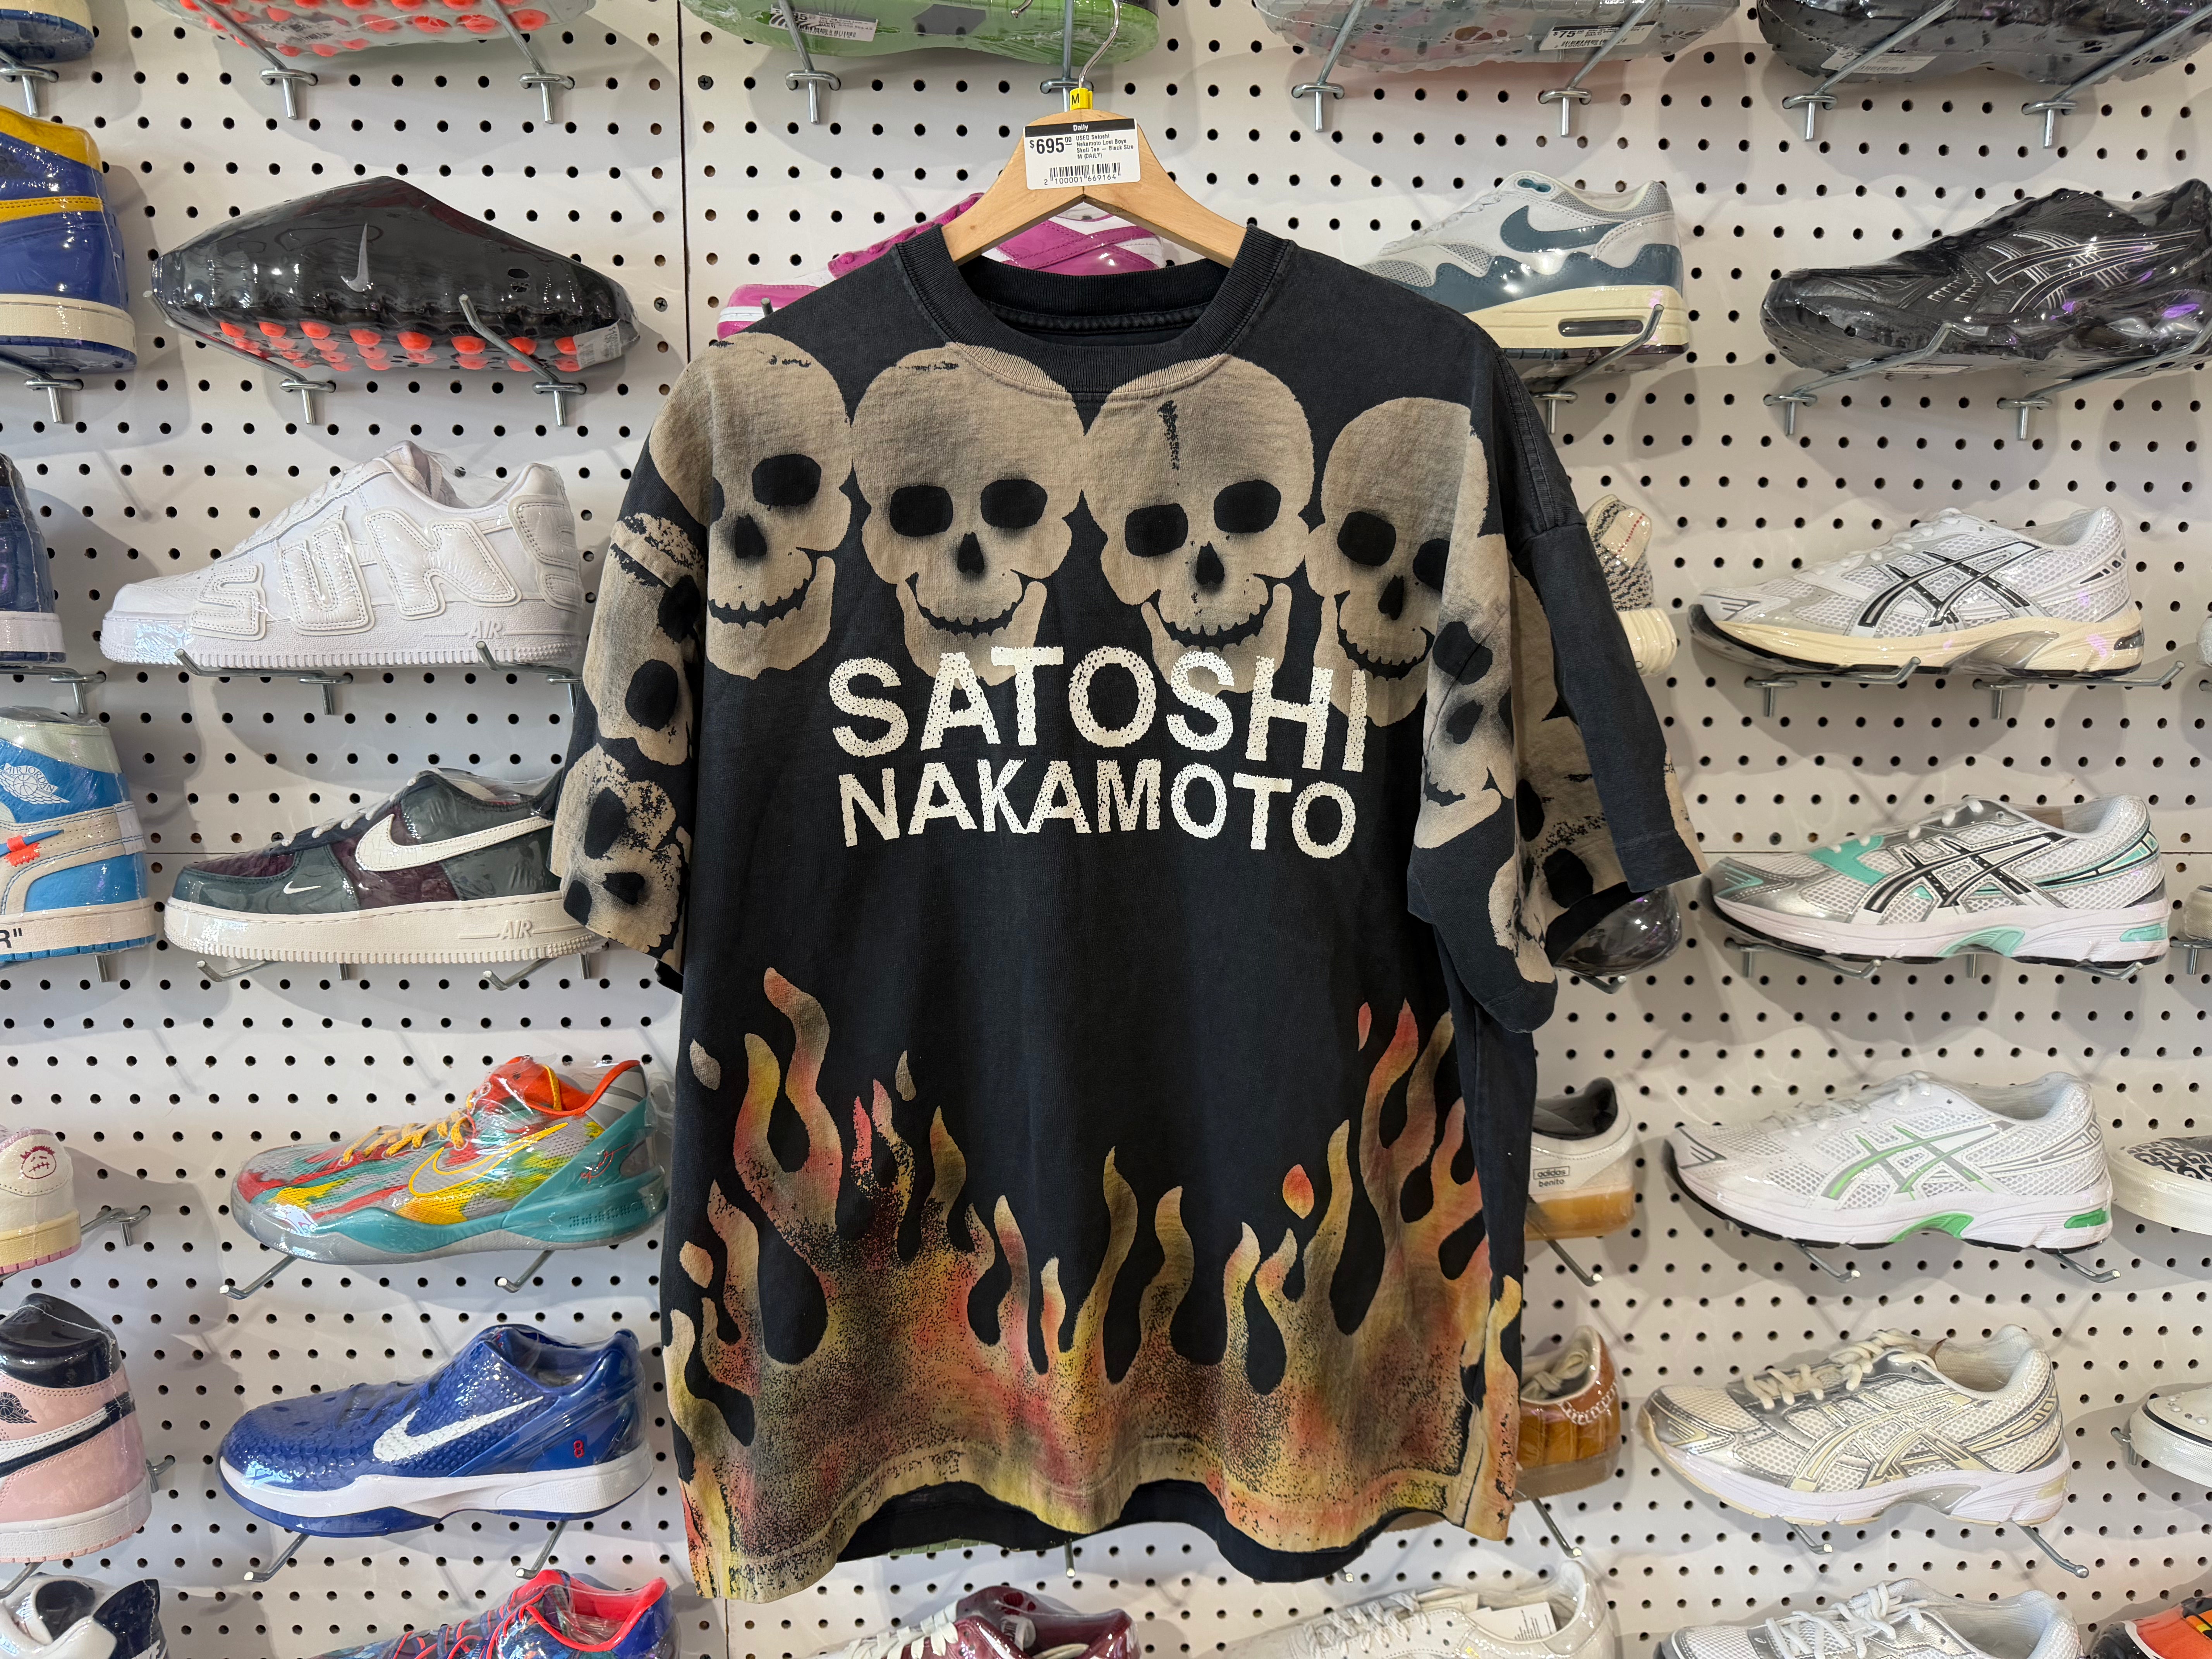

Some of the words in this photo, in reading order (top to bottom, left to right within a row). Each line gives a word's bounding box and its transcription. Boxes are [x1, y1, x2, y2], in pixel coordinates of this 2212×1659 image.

[1072, 93, 1080, 105] M
[1055, 177, 1082, 185] 100001
[1087, 174, 1116, 182] 669164
[469, 620, 503, 639] AIR
[828, 645, 1368, 773] SATOSHI
[5, 766, 22, 774] AIR
[25, 766, 55, 792] JORDAN
[838, 758, 1357, 859] NAKAMOTO
[501, 920, 533, 940] AIR
[1537, 1169, 1565, 1178] adidas
[1539, 1178, 1565, 1187] benito
[573, 1440, 584, 1458] 8
